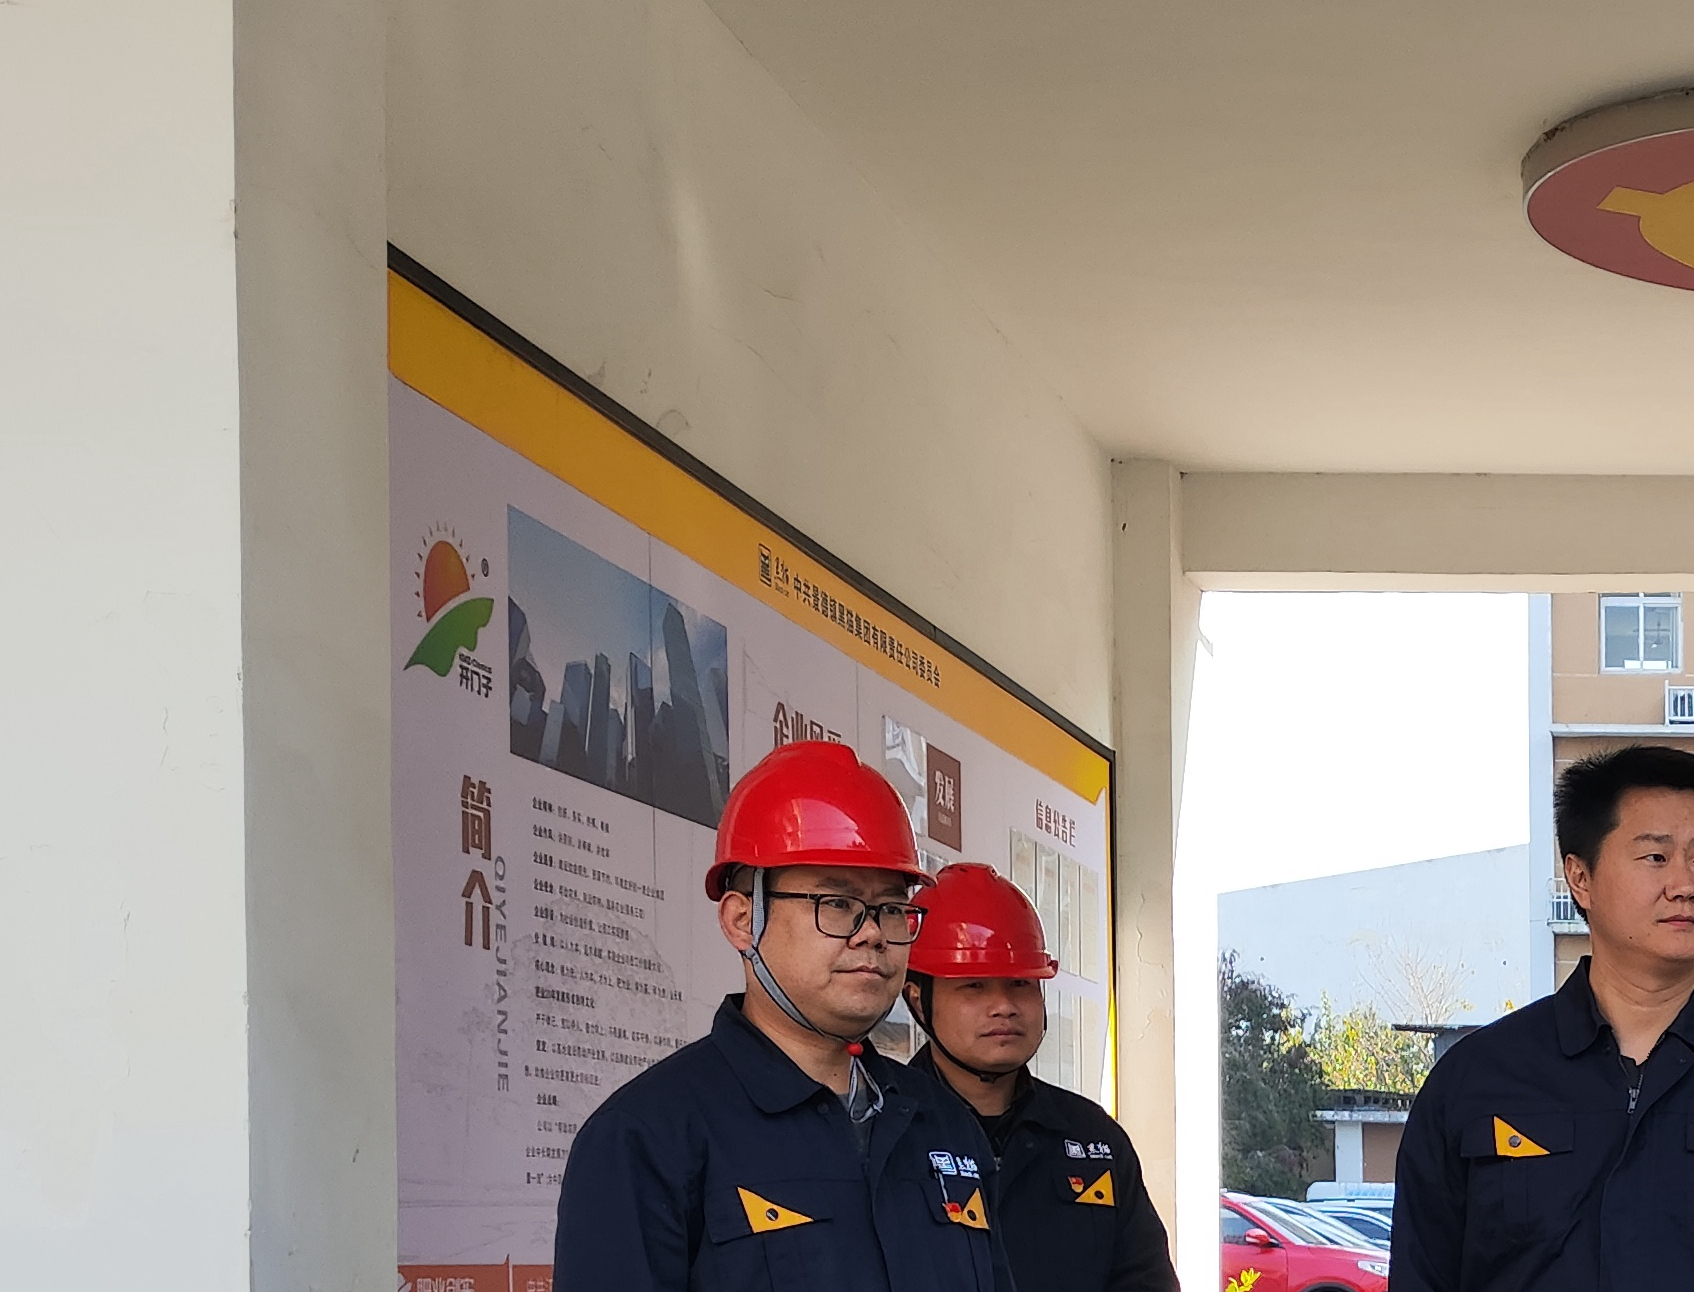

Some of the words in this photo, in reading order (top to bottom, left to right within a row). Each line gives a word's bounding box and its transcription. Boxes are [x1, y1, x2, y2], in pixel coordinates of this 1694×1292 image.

[793, 573, 941, 689] 中共景德镇黑猫集团有限责任公司委员会
[458, 664, 493, 699] 开门子
[772, 701, 842, 750] 企业风
[934, 769, 956, 813] 发展
[1035, 798, 1076, 848] 信息公告栏
[460, 774, 494, 951] 简介
[494, 855, 510, 1093] QIYEJIANJIE
